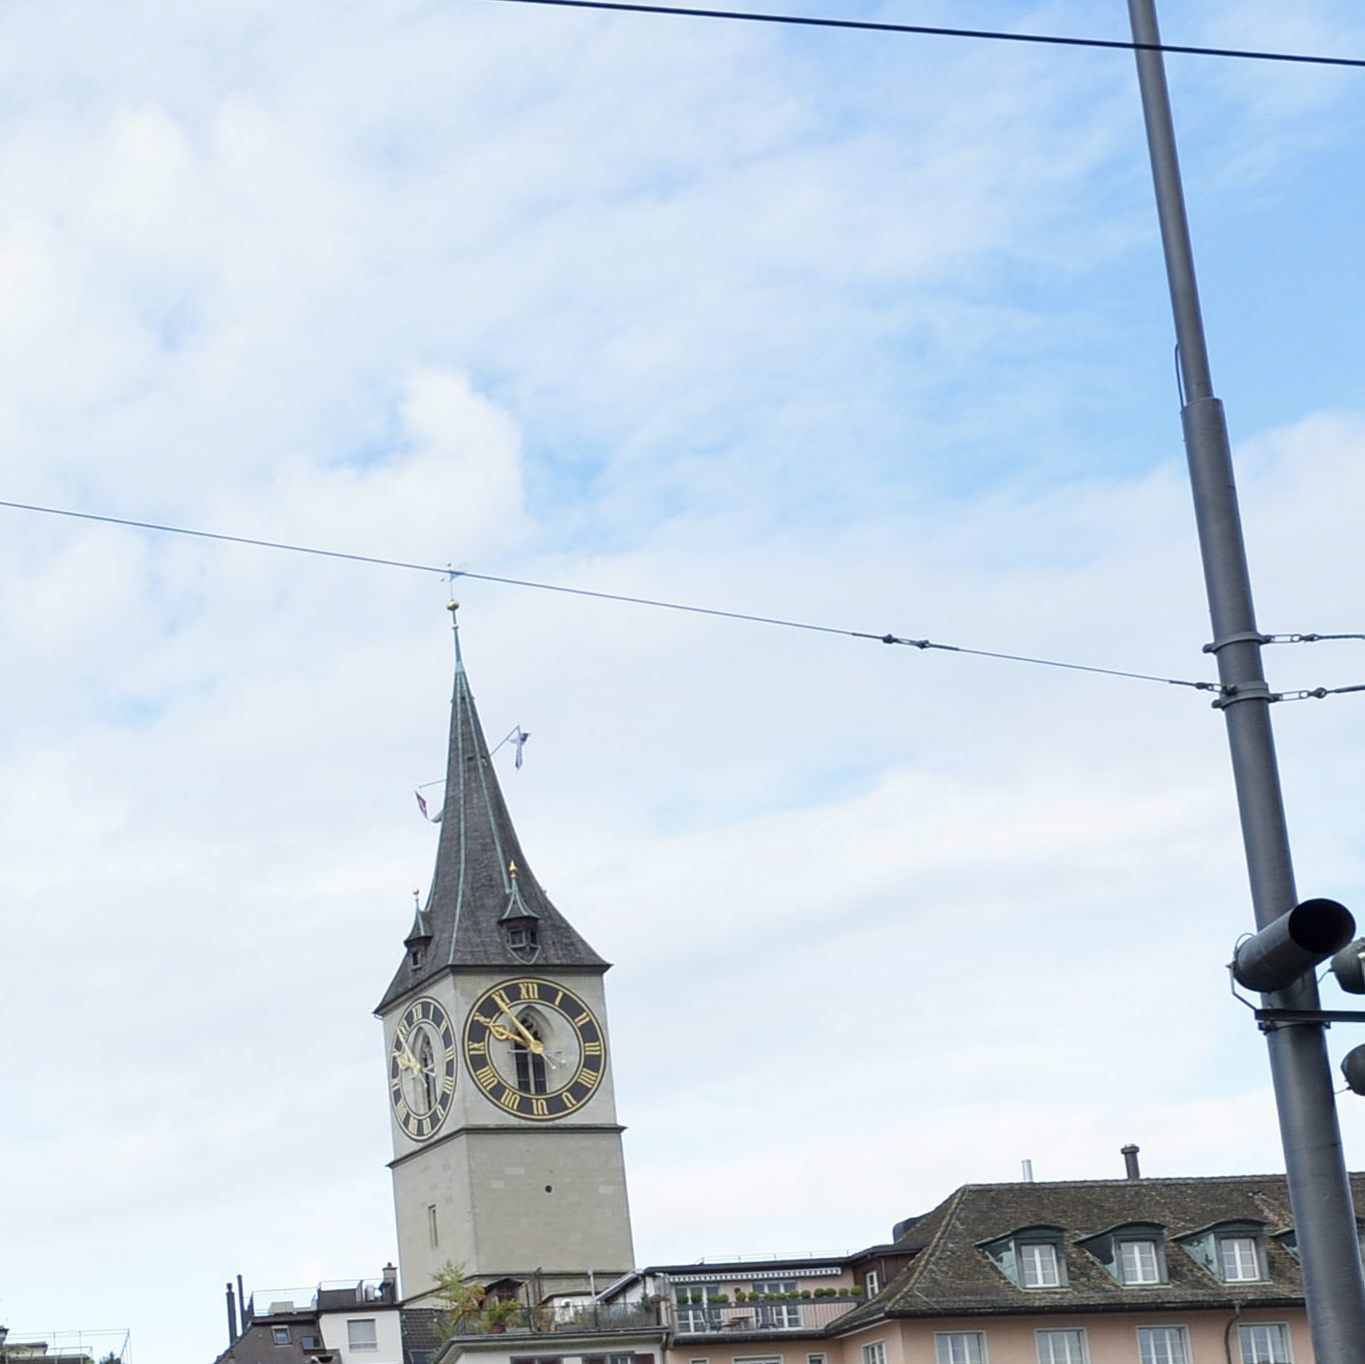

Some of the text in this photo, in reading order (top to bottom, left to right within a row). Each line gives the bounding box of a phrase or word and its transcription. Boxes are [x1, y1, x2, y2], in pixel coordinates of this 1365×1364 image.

[519, 983, 539, 999] XII
[554, 991, 564, 1006] I
[574, 1012, 590, 1027] II
[469, 1041, 485, 1055] IX
[584, 1041, 601, 1055] III
[476, 1065, 498, 1090] VIII
[576, 1067, 598, 1089] IIII
[500, 1089, 520, 1110] VII
[532, 1099, 549, 1115] VI
[562, 1092, 577, 1107] V
